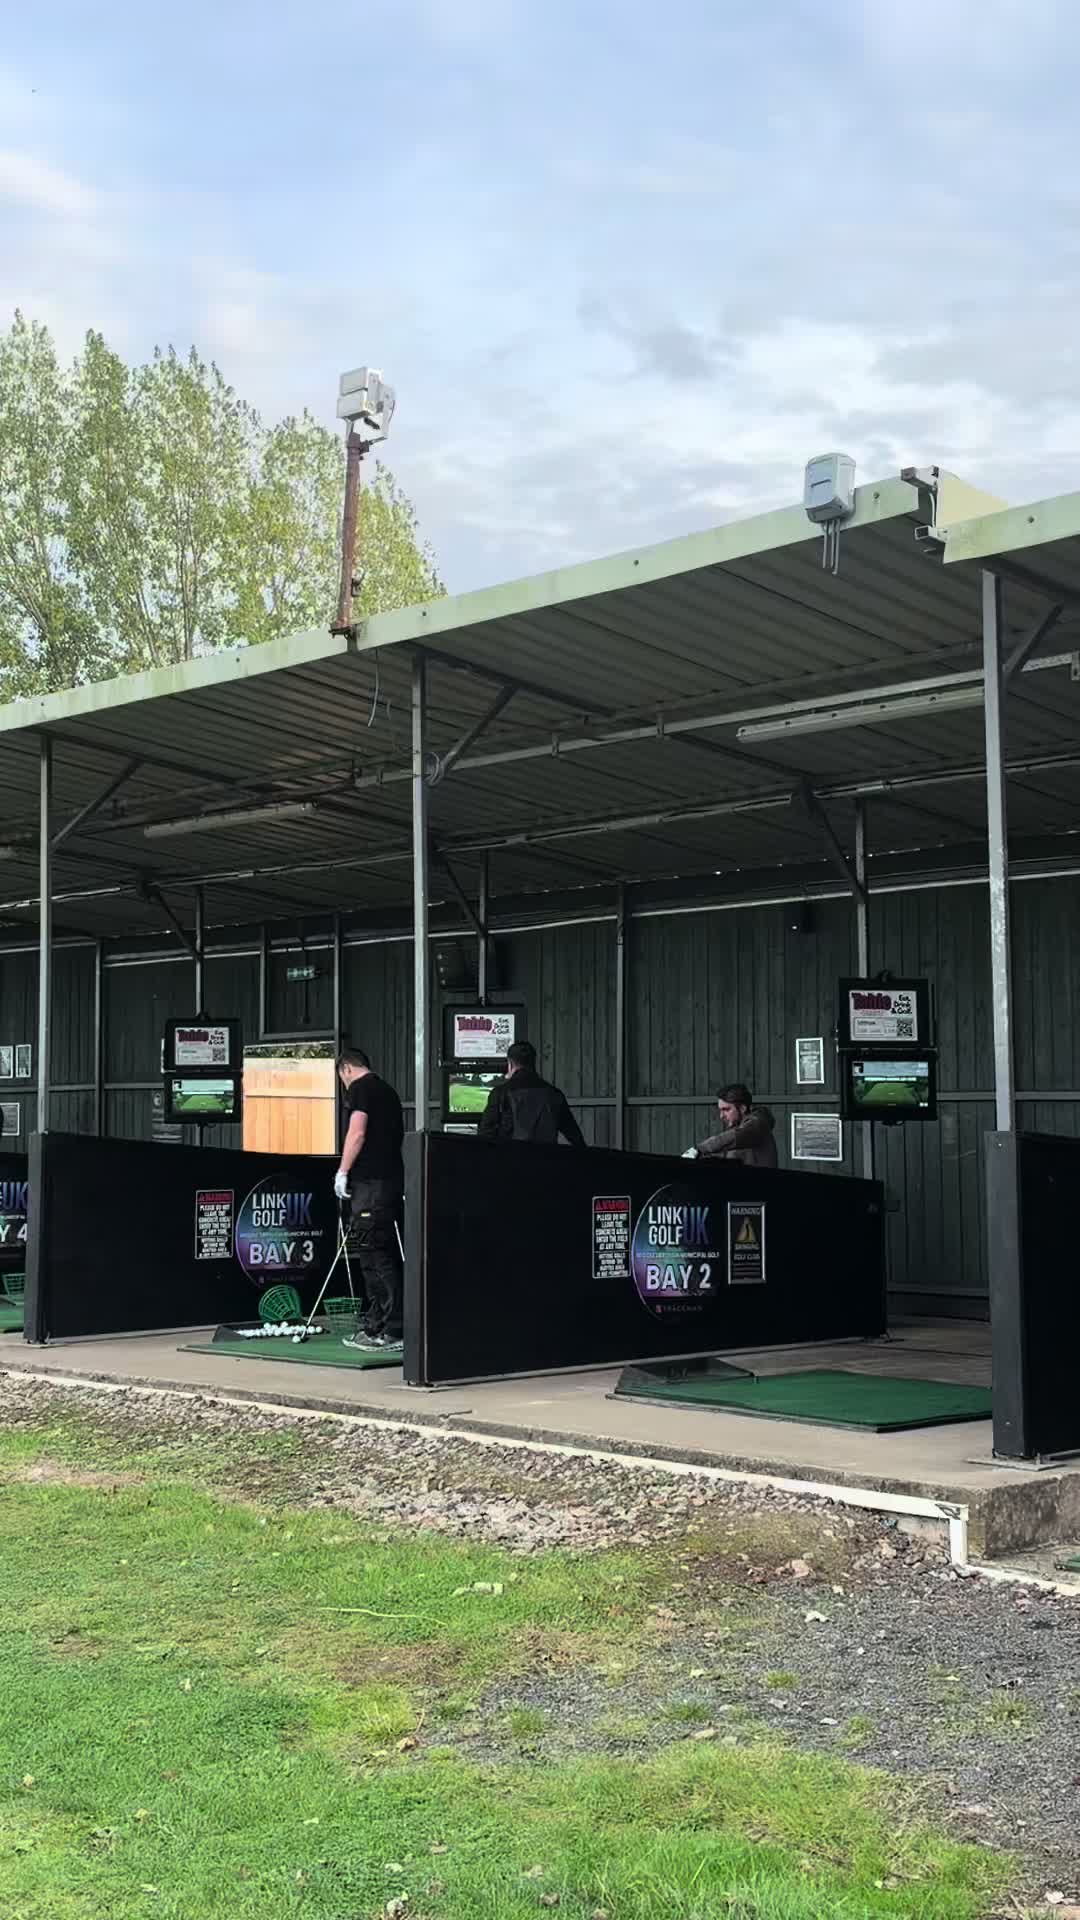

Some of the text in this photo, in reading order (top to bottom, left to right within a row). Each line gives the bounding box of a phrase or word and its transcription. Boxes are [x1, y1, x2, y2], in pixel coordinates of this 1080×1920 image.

[252, 1193, 287, 1209] LINK
[287, 1193, 312, 1226] UK
[252, 1209, 287, 1227] GOLF
[648, 1206, 683, 1224] LINK
[683, 1206, 710, 1245] UK
[16, 1222, 28, 1242] 4
[648, 1225, 684, 1246] GOLF
[249, 1241, 296, 1265] BAY
[302, 1239, 314, 1263] 3
[646, 1264, 693, 1290] BAY
[698, 1263, 712, 1289] 2
